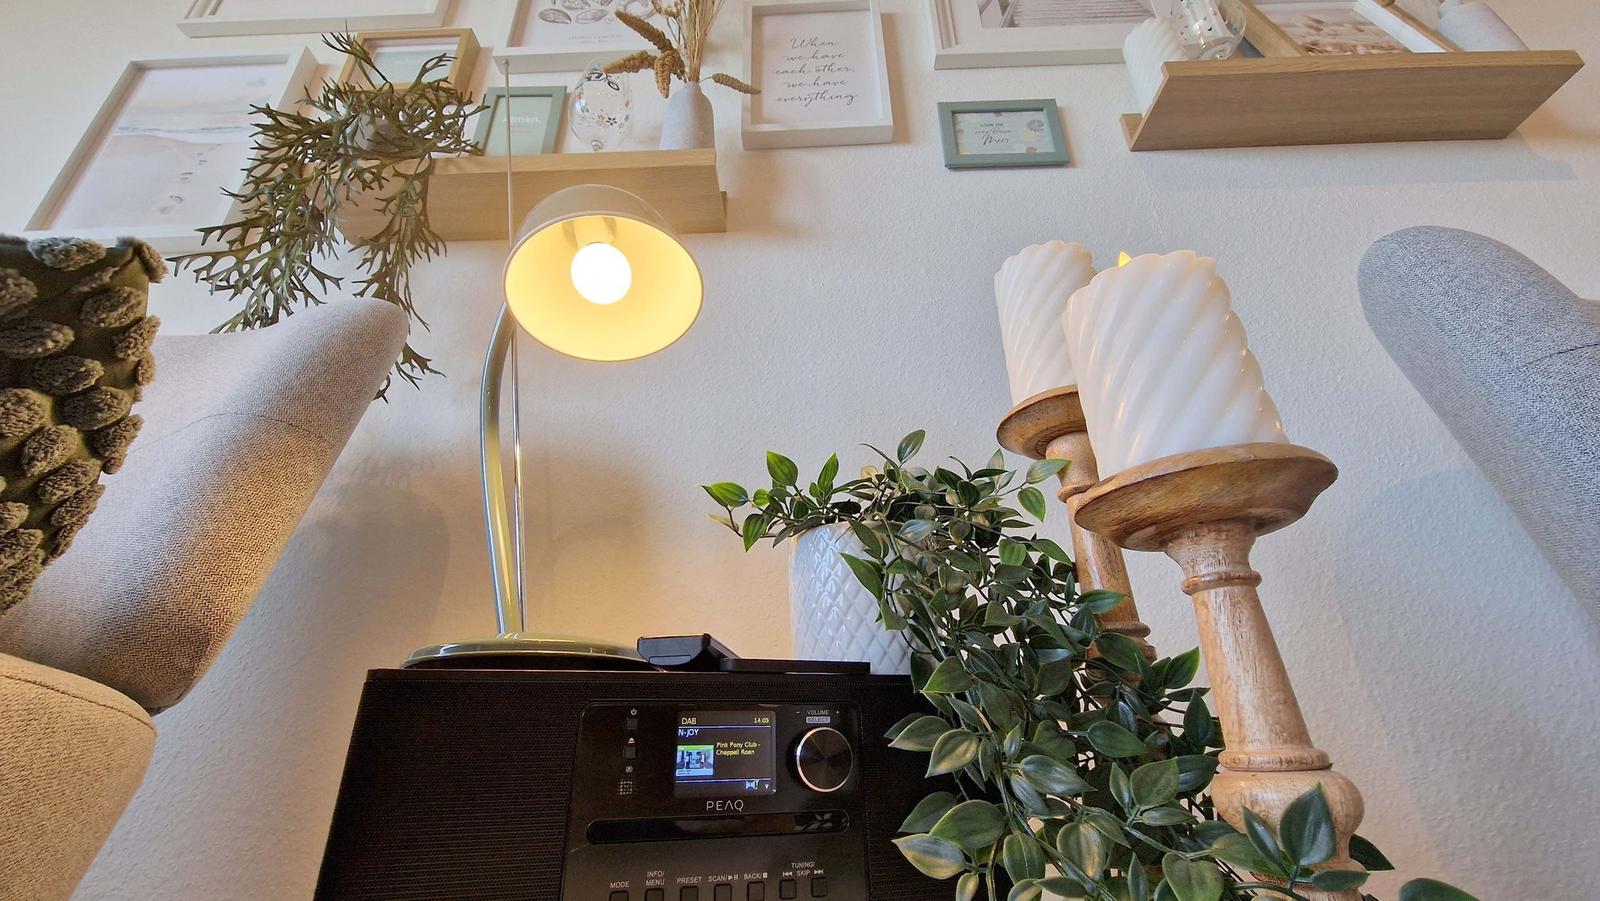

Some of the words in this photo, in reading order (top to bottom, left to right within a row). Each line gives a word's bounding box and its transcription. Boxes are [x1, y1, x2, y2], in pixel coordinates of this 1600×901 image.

[790, 36, 836, 49] When
[808, 49, 846, 60] have
[774, 63, 810, 75] each
[809, 75, 848, 86] have
[774, 89, 859, 108] everything
[681, 717, 697, 725] DAB
[678, 728, 699, 738] N-JOY
[646, 870, 665, 878] INFO/
[796, 869, 811, 877] SKIP
[609, 881, 630, 889] MODE
[676, 876, 702, 885] PRESET
